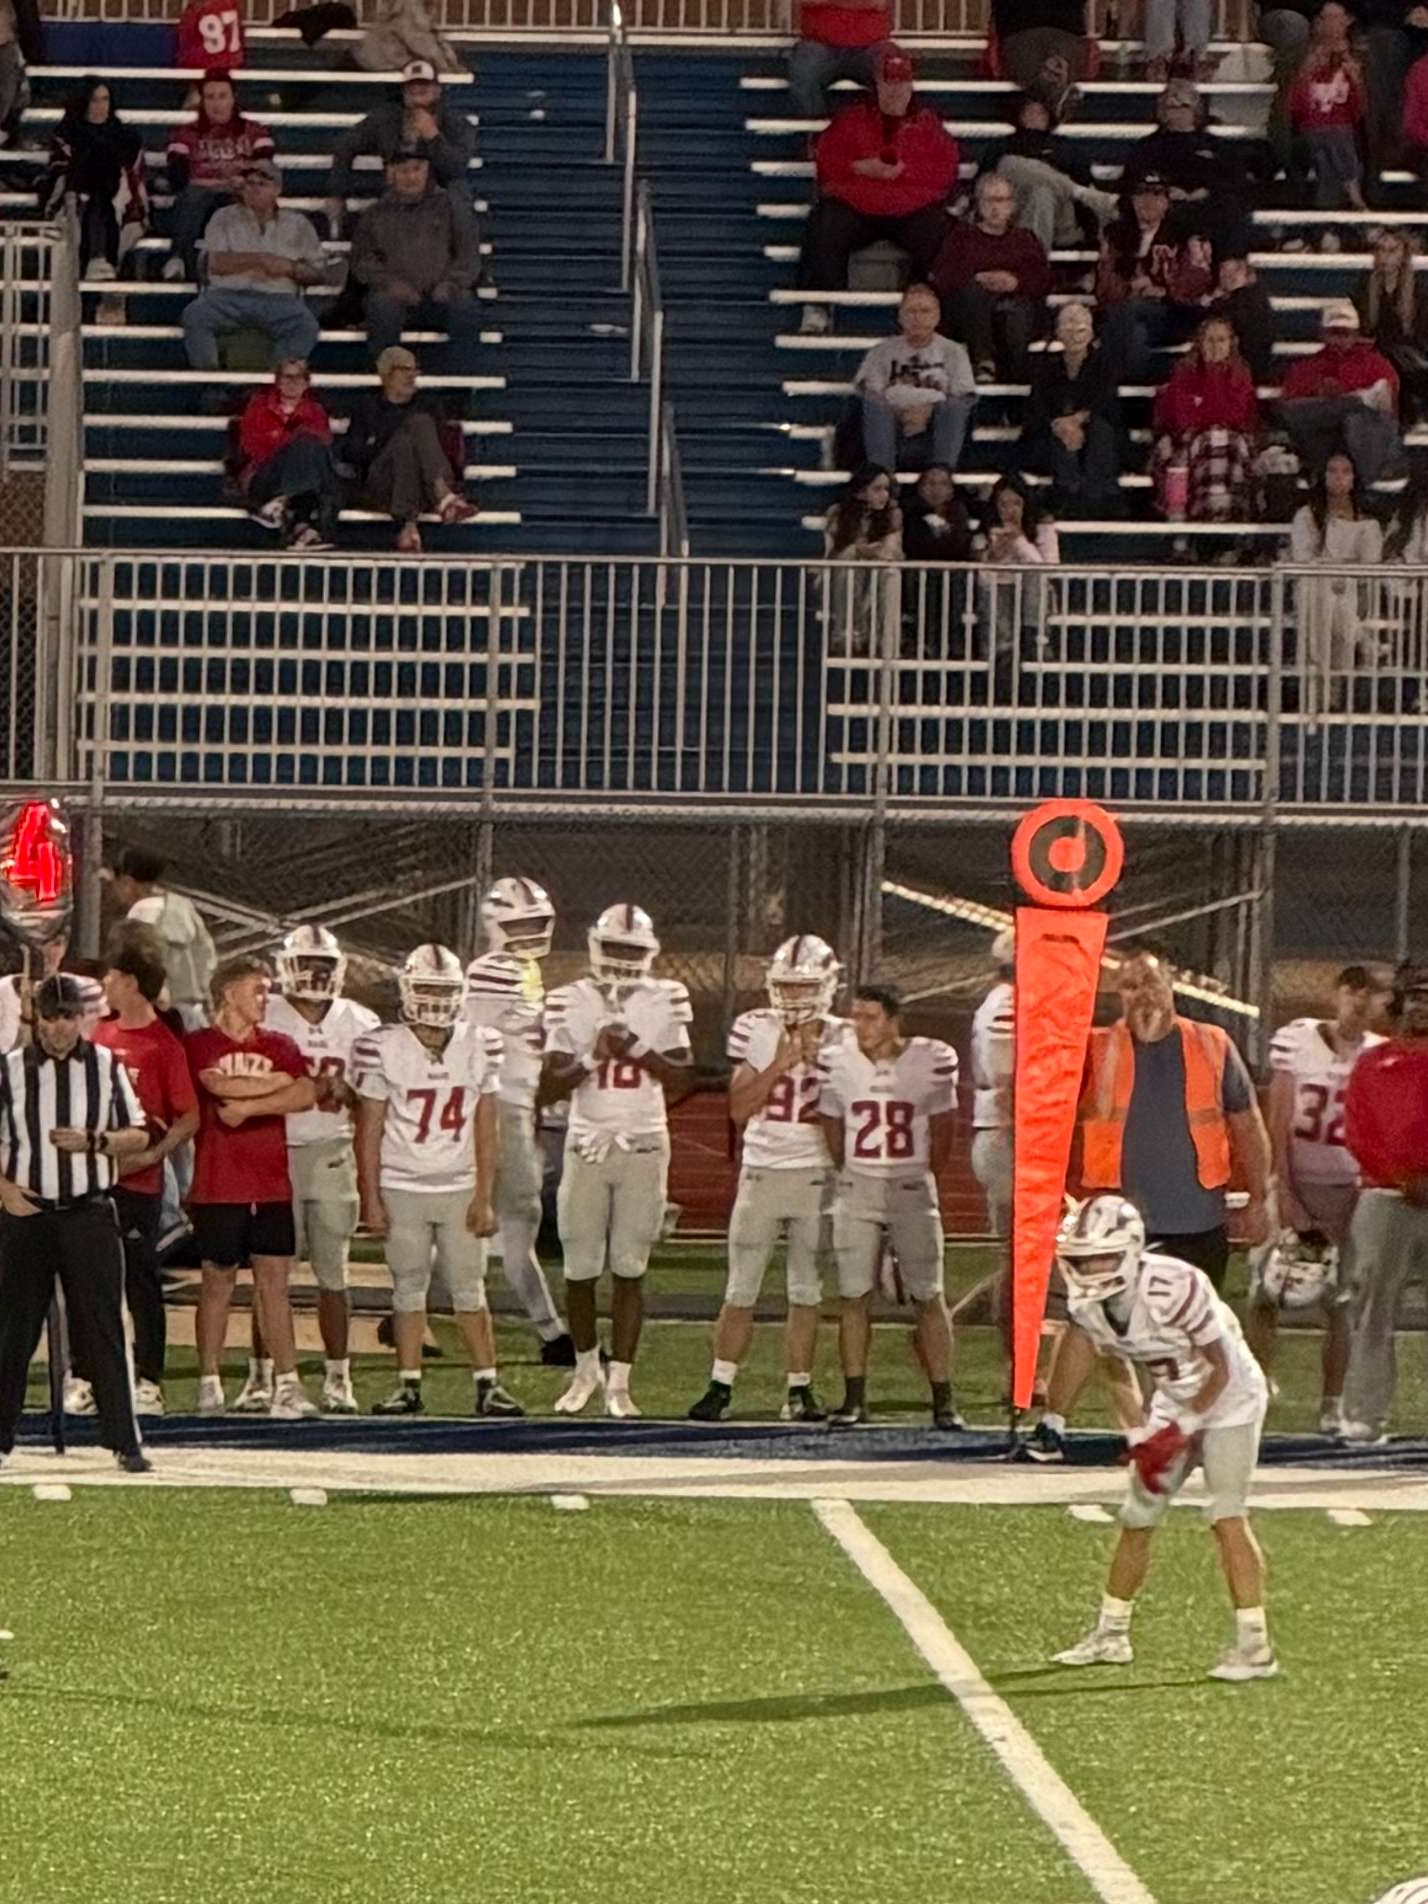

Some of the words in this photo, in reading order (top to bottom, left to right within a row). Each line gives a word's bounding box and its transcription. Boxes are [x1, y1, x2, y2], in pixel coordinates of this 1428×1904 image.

[6, 799, 63, 904] 4
[405, 1086, 468, 1144] 74
[852, 1102, 916, 1160] 28
